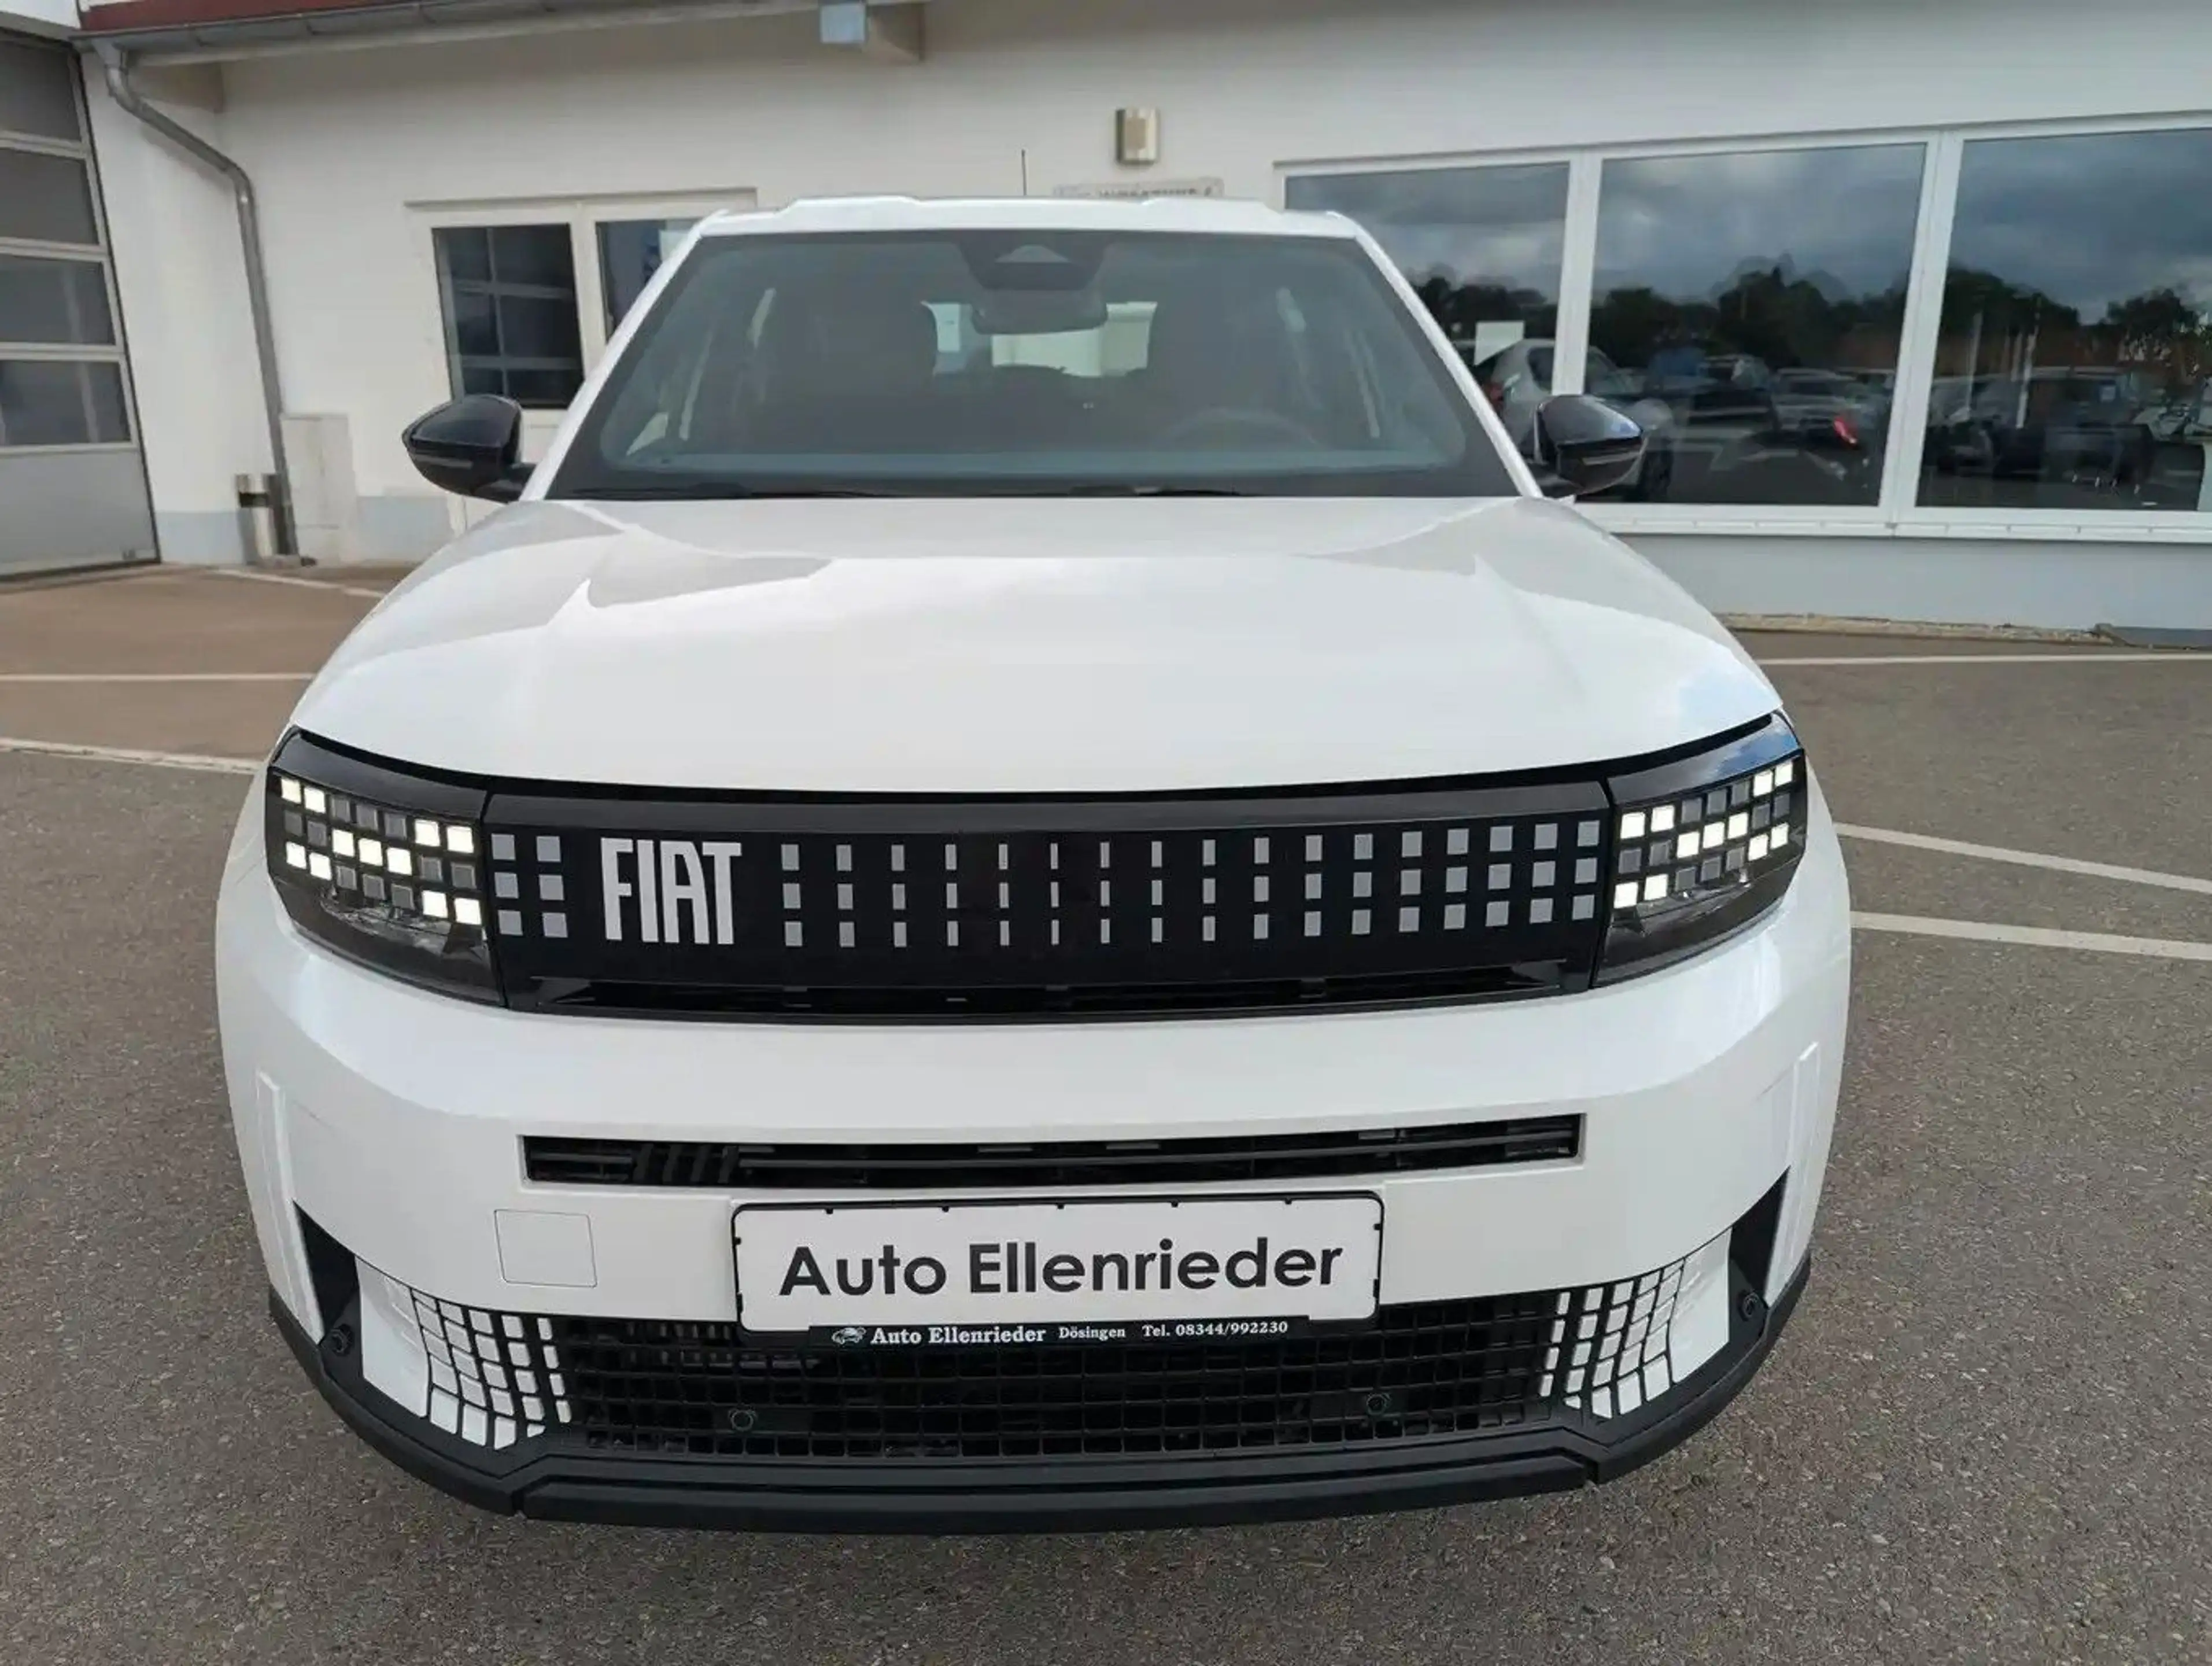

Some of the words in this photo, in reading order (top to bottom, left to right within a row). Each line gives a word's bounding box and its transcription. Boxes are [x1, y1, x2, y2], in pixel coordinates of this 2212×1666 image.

[600, 837, 743, 945] FIAT
[778, 1244, 947, 1296] Auto
[969, 1237, 1343, 1293] Ellenrieder
[870, 1327, 922, 1344] Auto
[928, 1325, 1046, 1343] Ellenrieder
[1058, 1326, 1126, 1341] Dösingen
[1142, 1325, 1171, 1337] Tel.
[1175, 1321, 1288, 1336] 08344/992230
